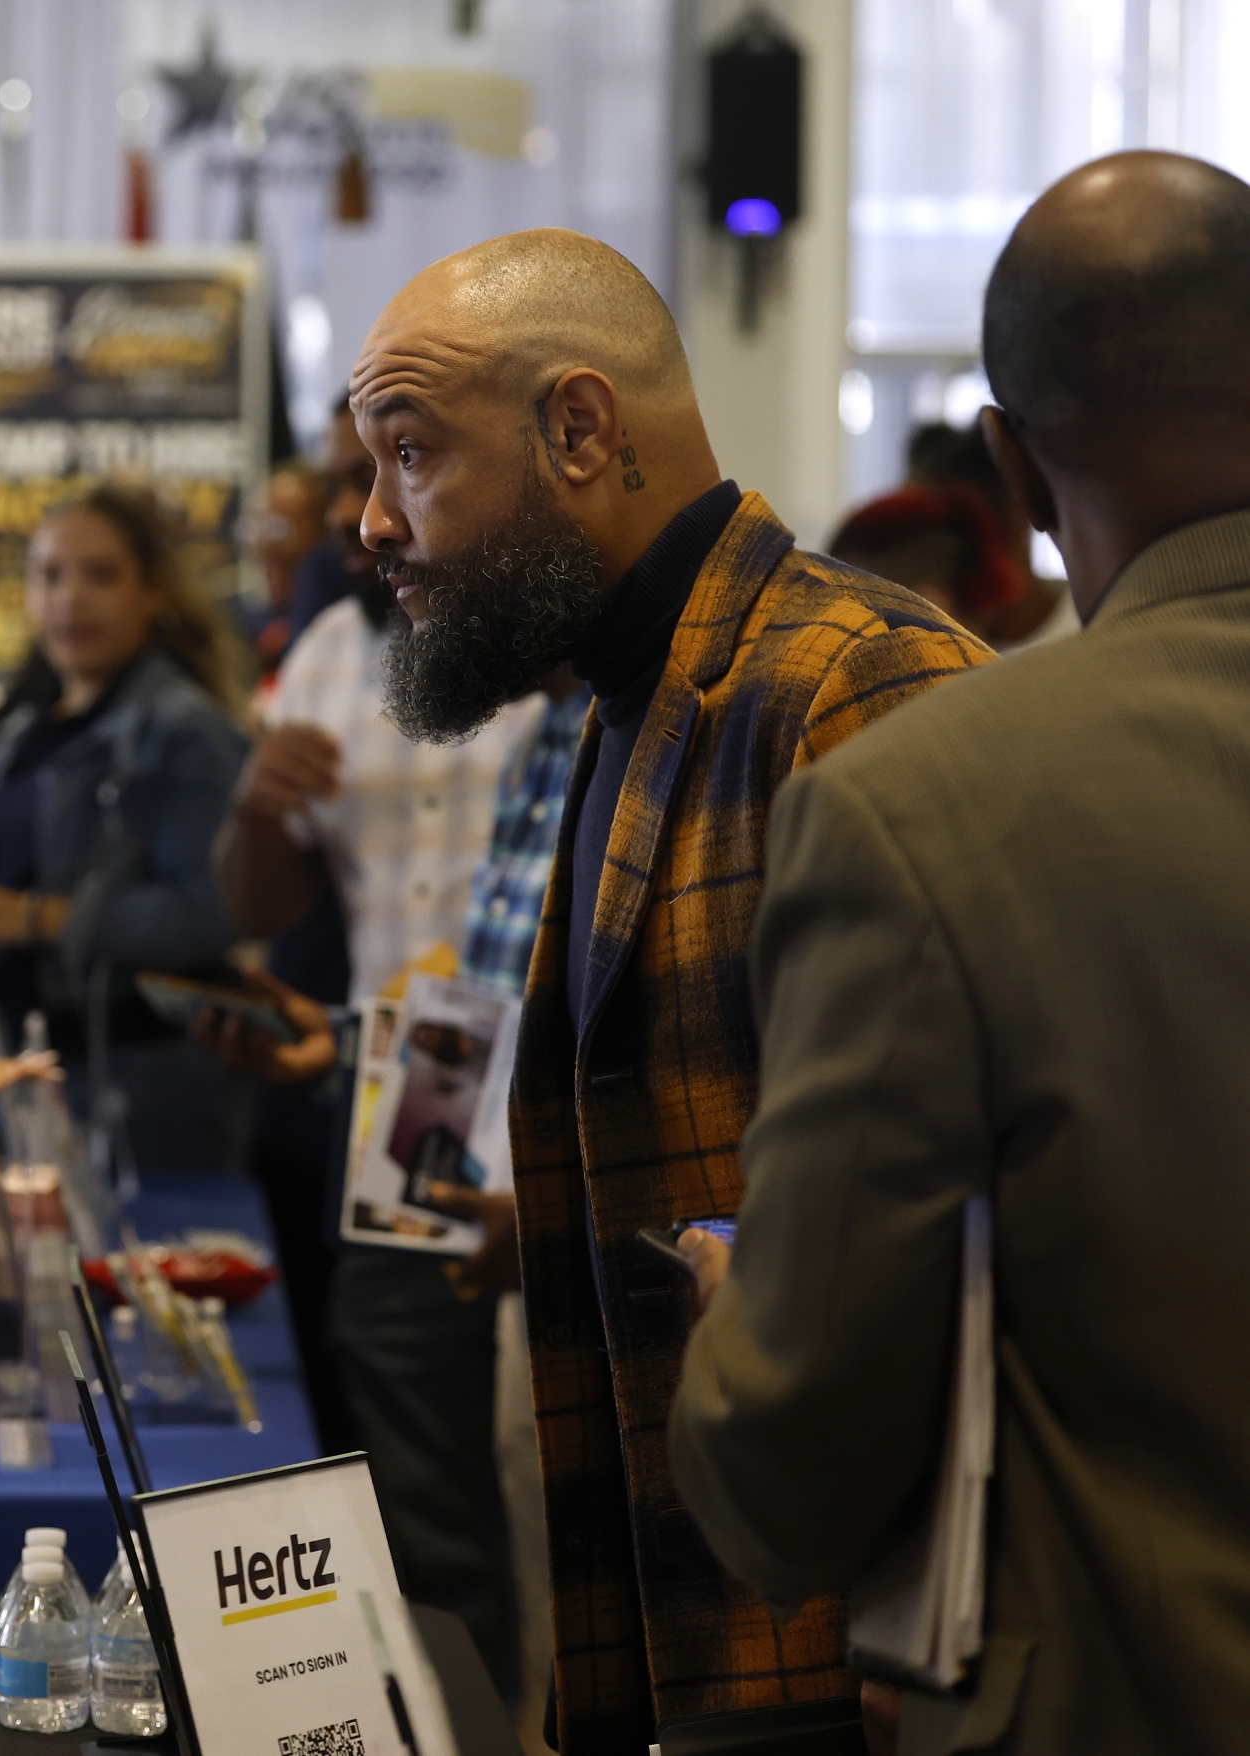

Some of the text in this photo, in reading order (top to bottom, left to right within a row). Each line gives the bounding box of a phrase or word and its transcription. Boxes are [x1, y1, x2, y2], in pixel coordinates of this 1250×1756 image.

[618, 445, 637, 468] 10
[622, 469, 646, 493] 82
[214, 1533, 336, 1609] Hertz
[255, 1650, 348, 1685] SCAN TO SIGN IN
